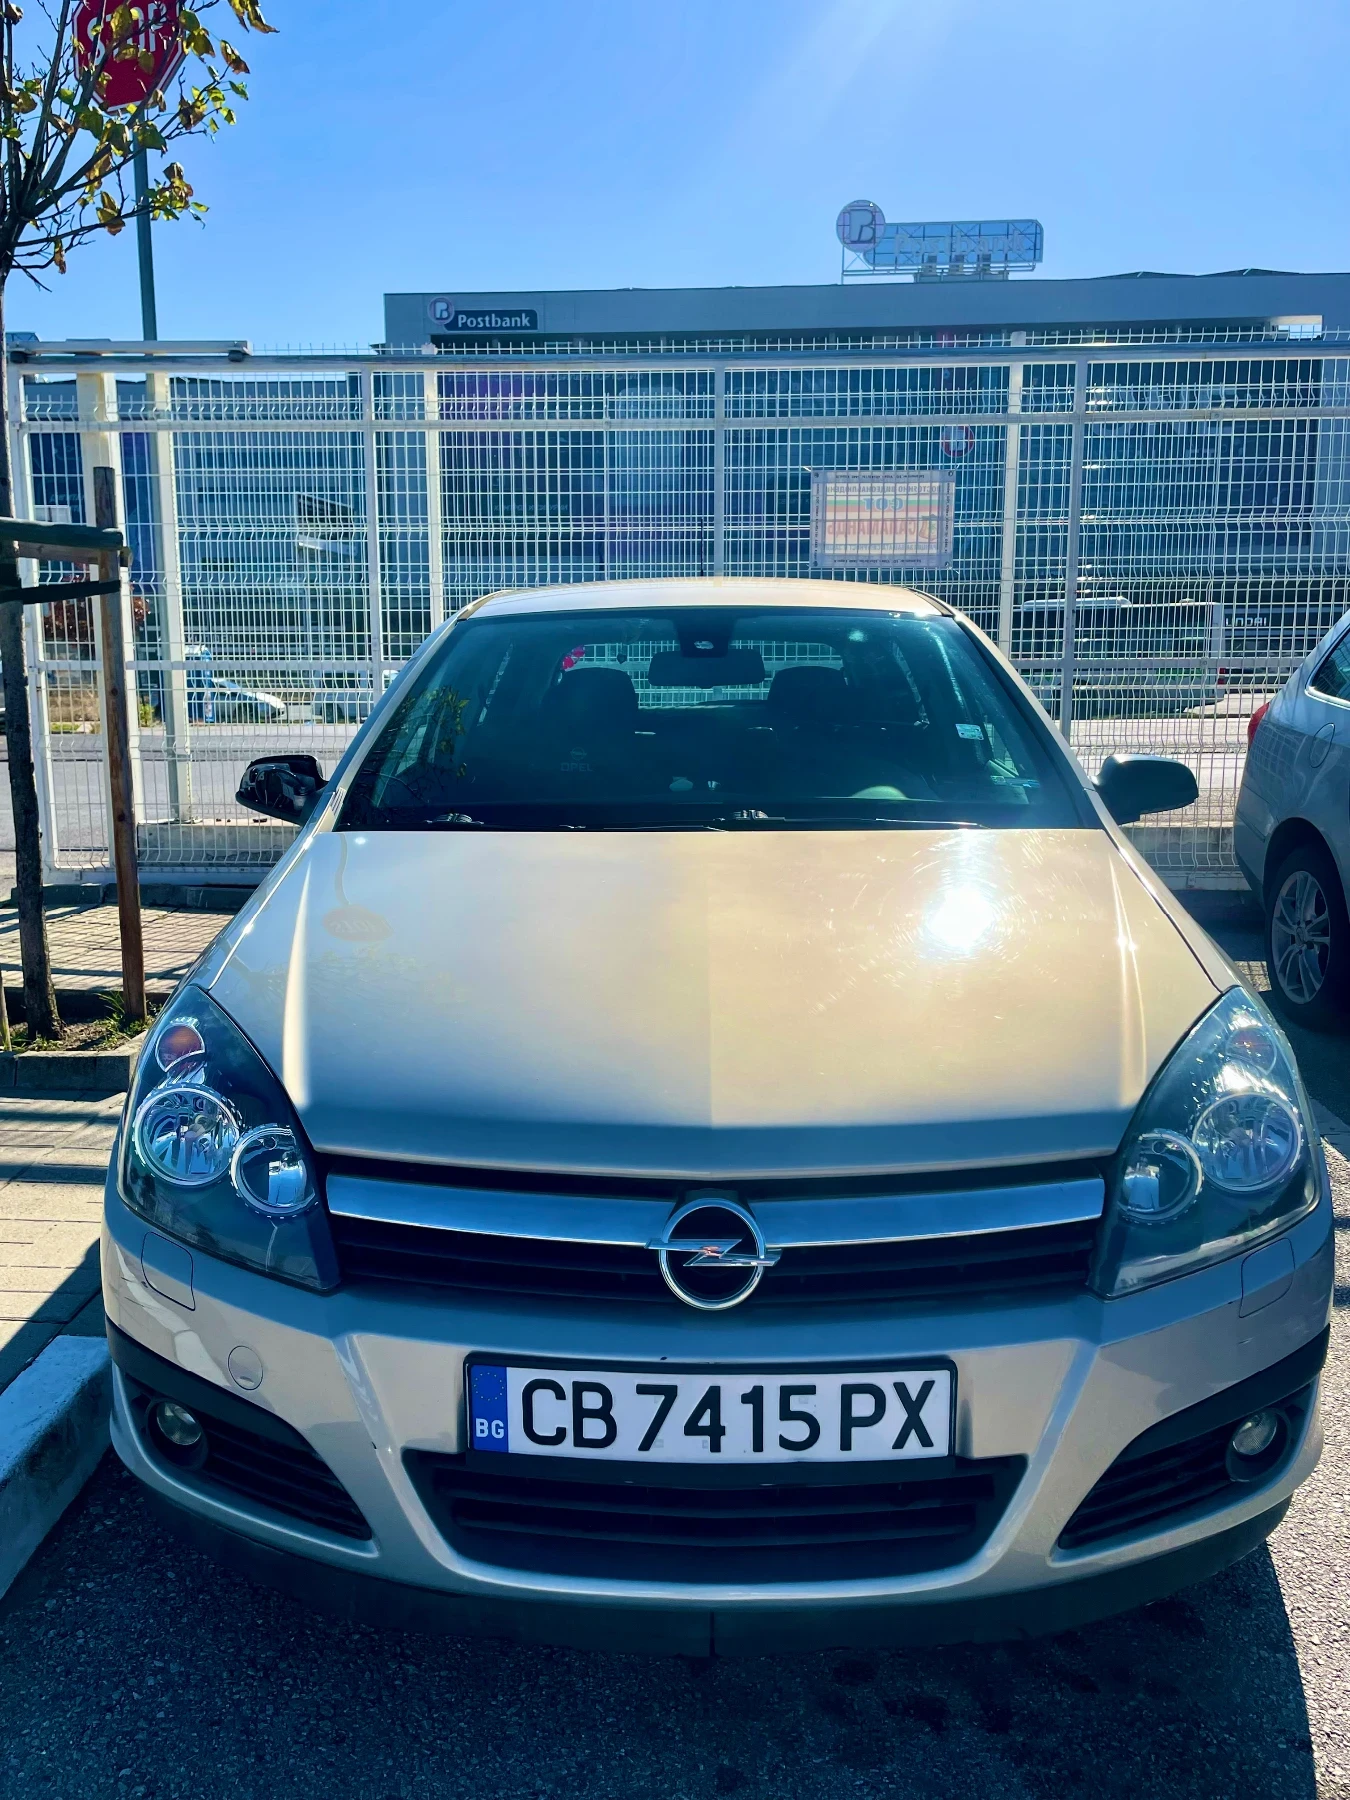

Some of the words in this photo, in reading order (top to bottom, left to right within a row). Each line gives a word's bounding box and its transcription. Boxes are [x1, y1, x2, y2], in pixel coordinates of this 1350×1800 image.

[894, 229, 1027, 256] Postbank
[457, 313, 531, 328] Postbank
[559, 762, 594, 773] OPEL
[521, 1378, 618, 1450] CB
[634, 1383, 821, 1453] 7415
[839, 1379, 936, 1452] PX
[475, 1418, 505, 1439] BG
